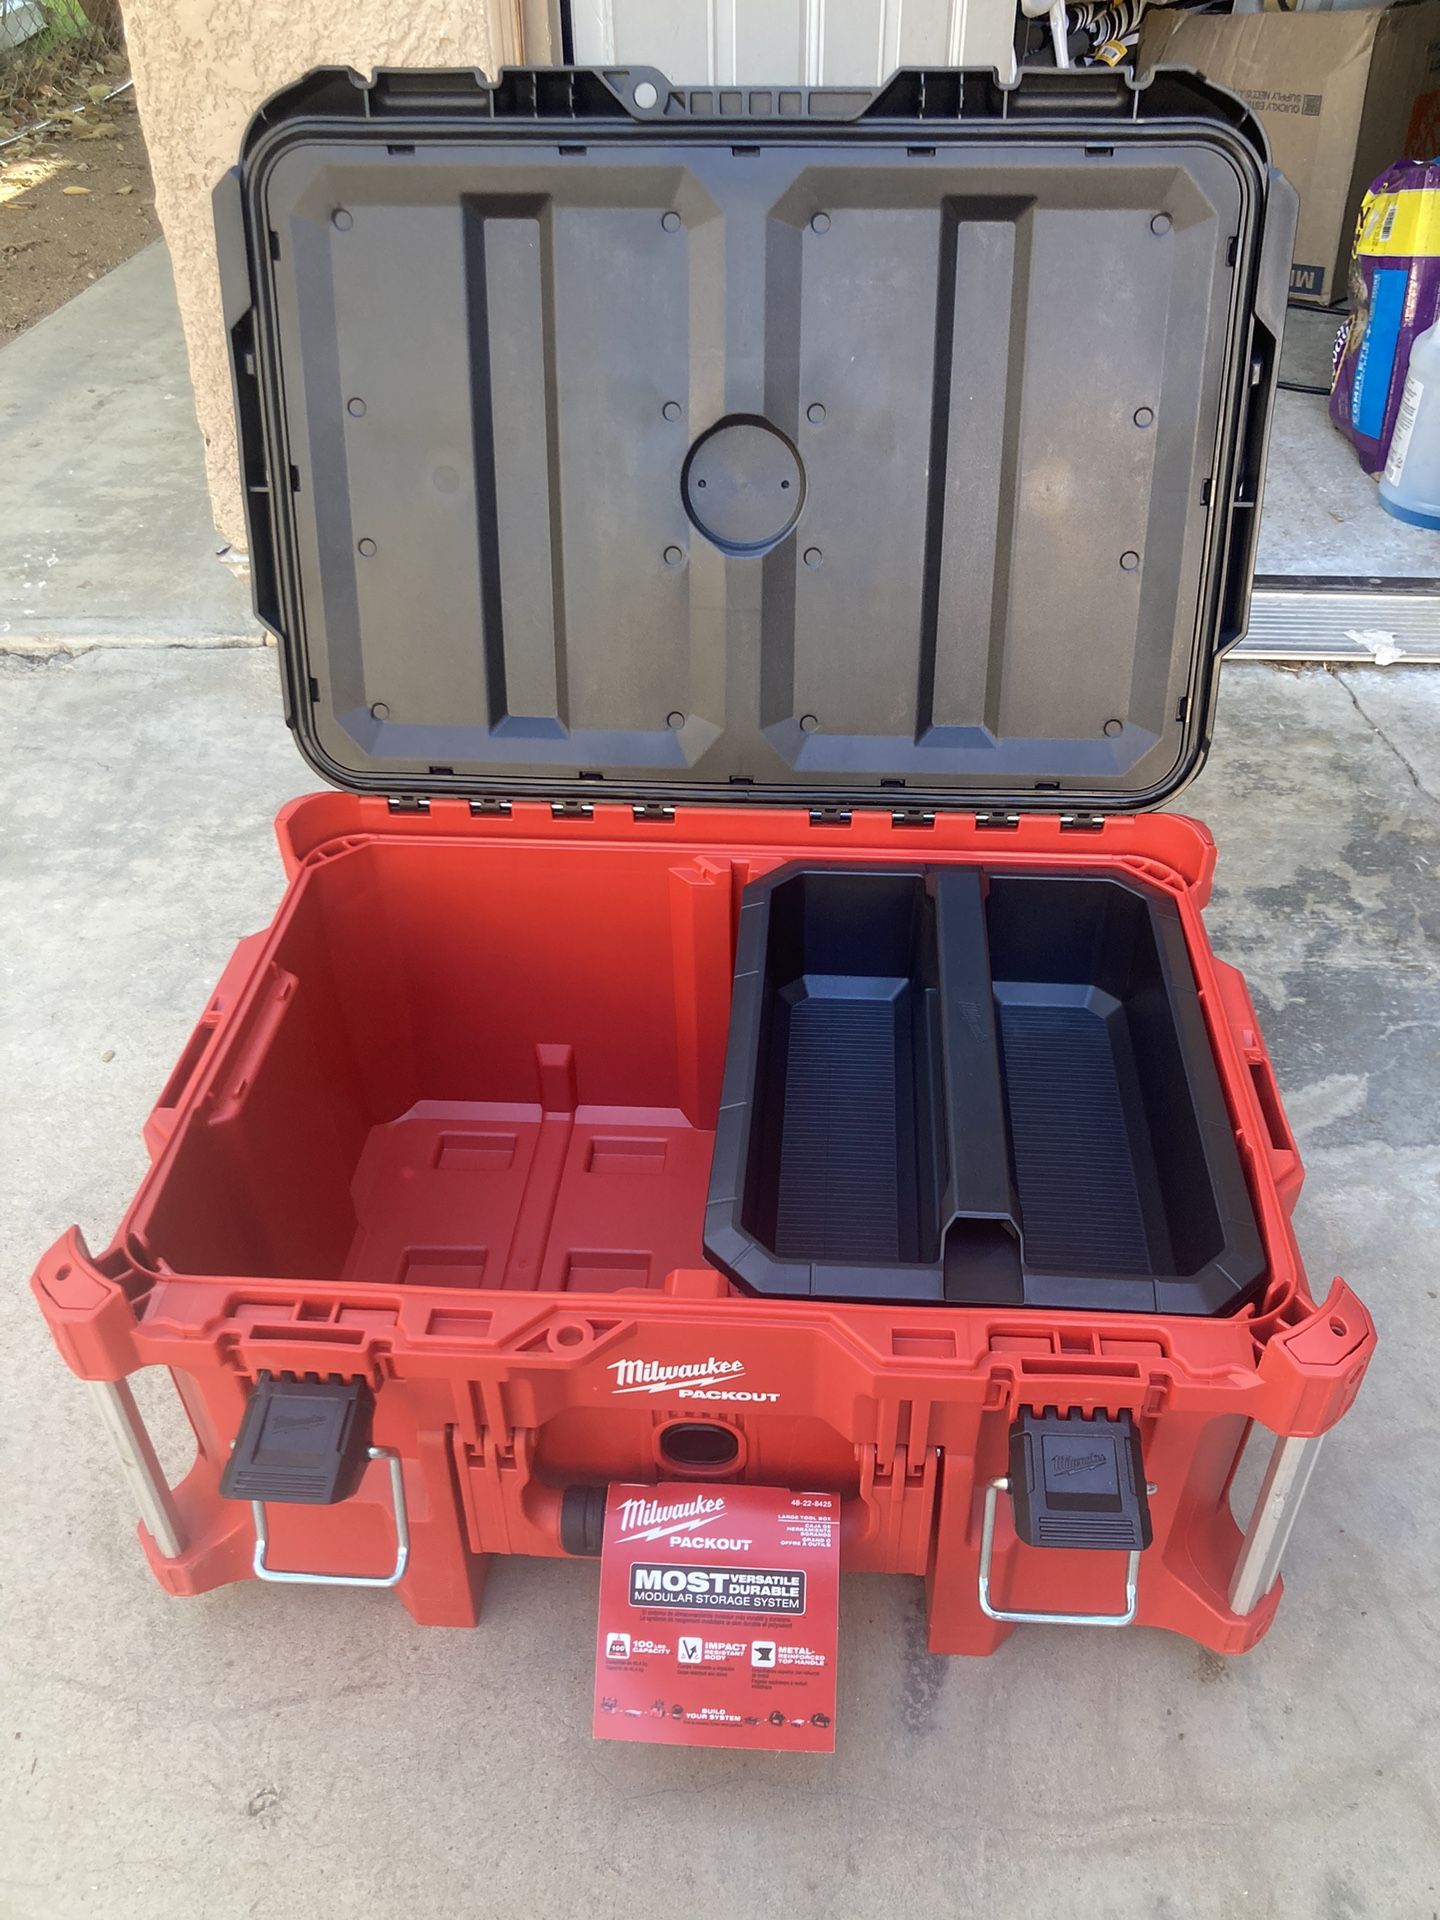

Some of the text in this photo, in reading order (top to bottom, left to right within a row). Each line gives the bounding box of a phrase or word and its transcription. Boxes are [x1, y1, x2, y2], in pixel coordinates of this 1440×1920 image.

[607, 1357, 745, 1386] Milwaukee
[678, 1389, 780, 1402] PACKOUT
[616, 1494, 726, 1531] Milwaukee
[669, 1536, 753, 1551] PACKOUT
[635, 1569, 800, 1593] MOST VERSATILE
[729, 1585, 800, 1597] DURABLE
[634, 1591, 800, 1608] MODULAR STORAGE SYSTEM
[632, 1640, 654, 1648] 100
[704, 1641, 747, 1651] IMPACT
[778, 1653, 826, 1661] REINFORCED
